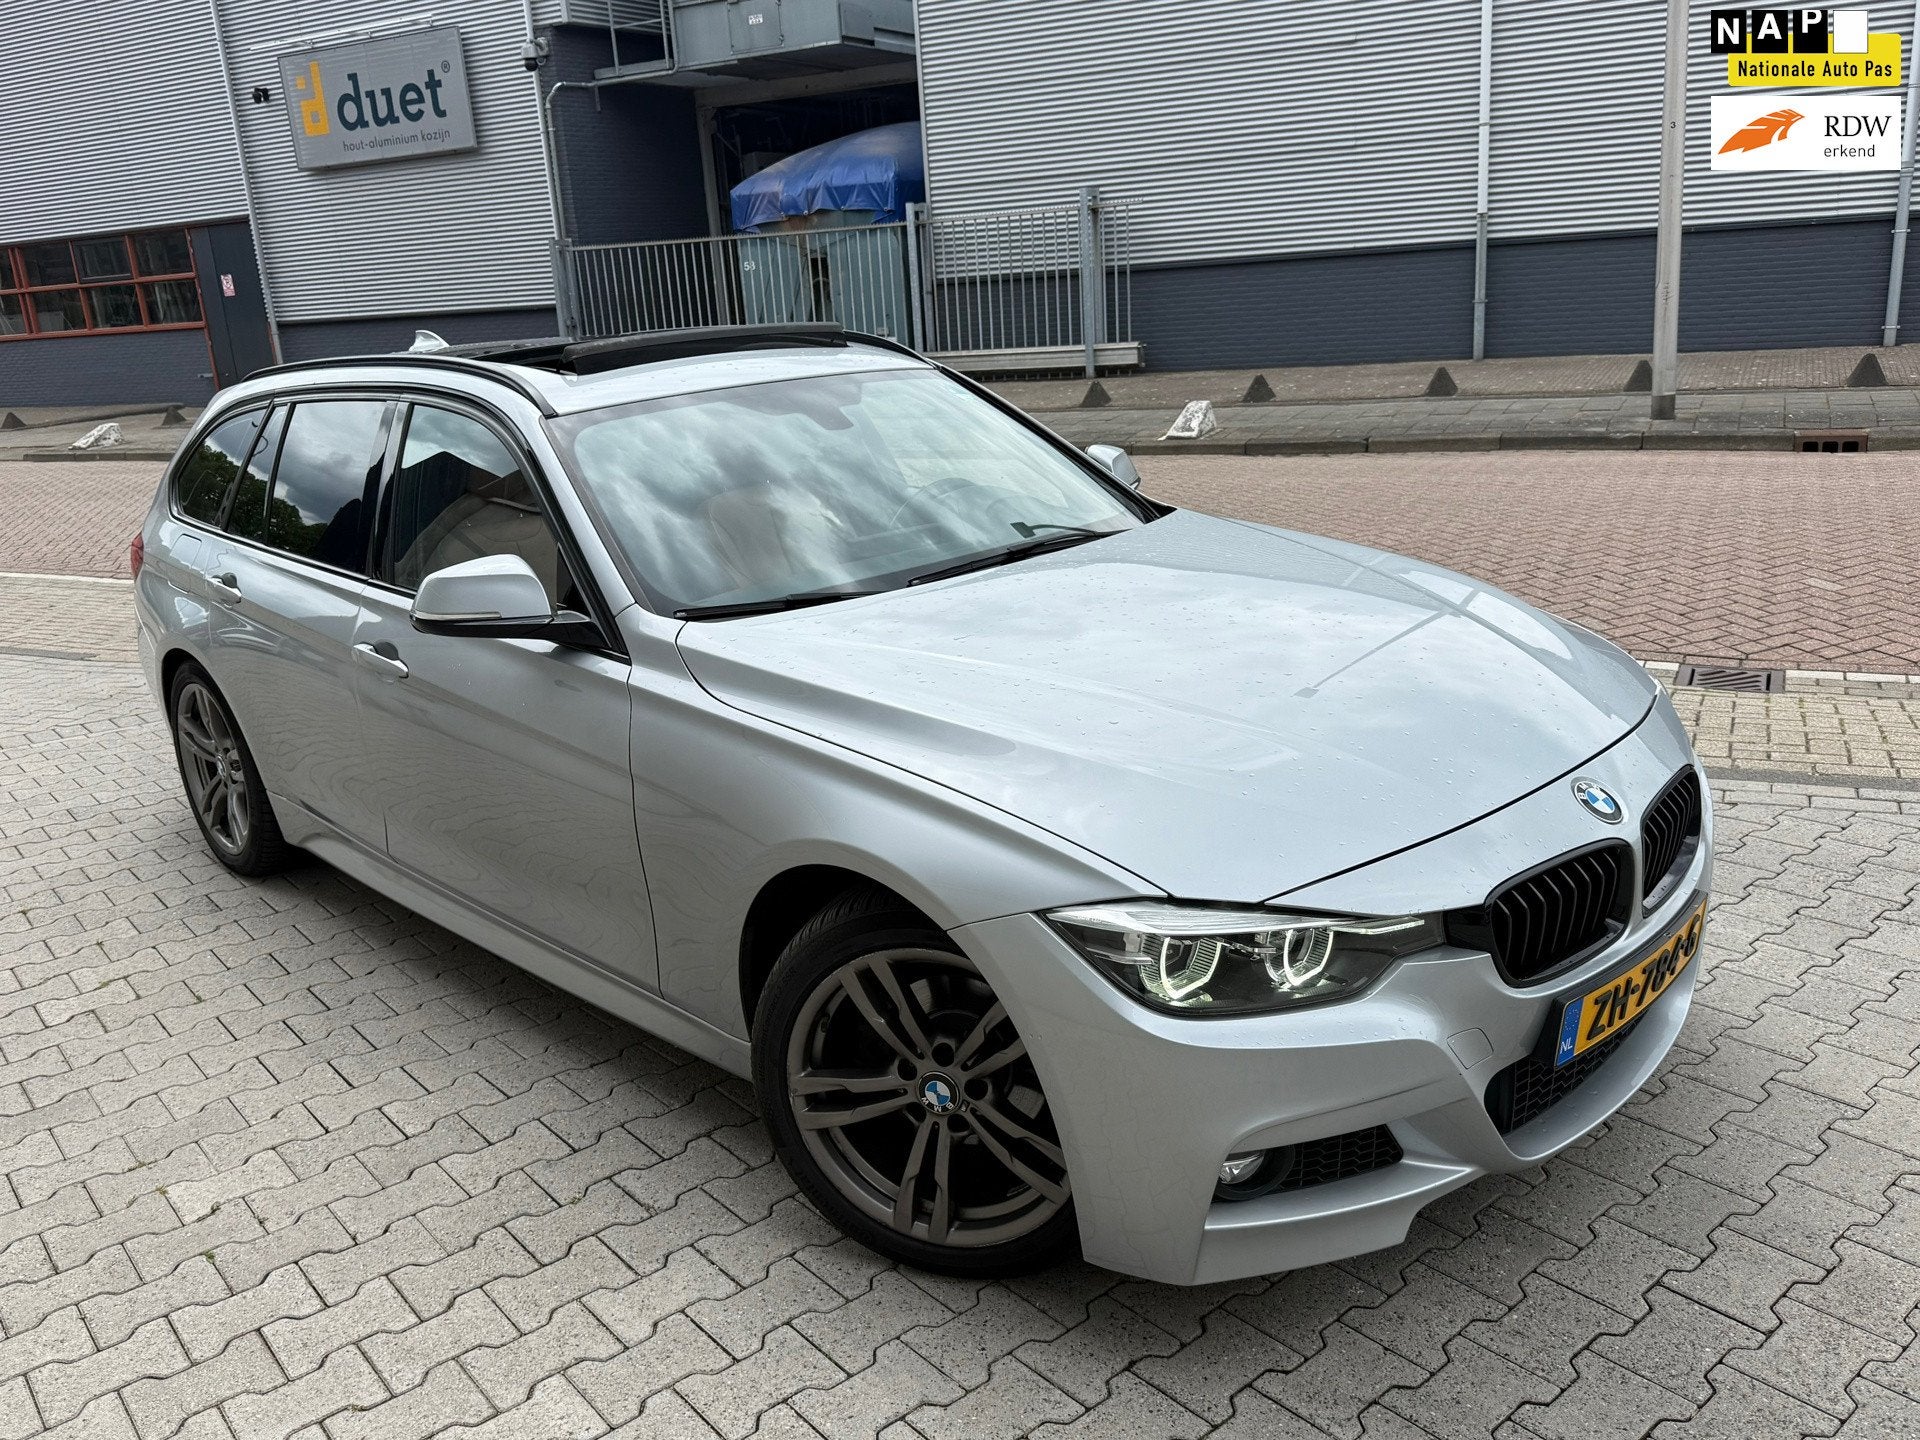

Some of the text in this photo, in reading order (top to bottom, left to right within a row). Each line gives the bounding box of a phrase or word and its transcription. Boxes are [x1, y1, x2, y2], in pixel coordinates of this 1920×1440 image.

[337, 68, 447, 131] duet
[343, 128, 451, 152] hout-aluminium kozijn
[1560, 1038, 1573, 1054] NL
